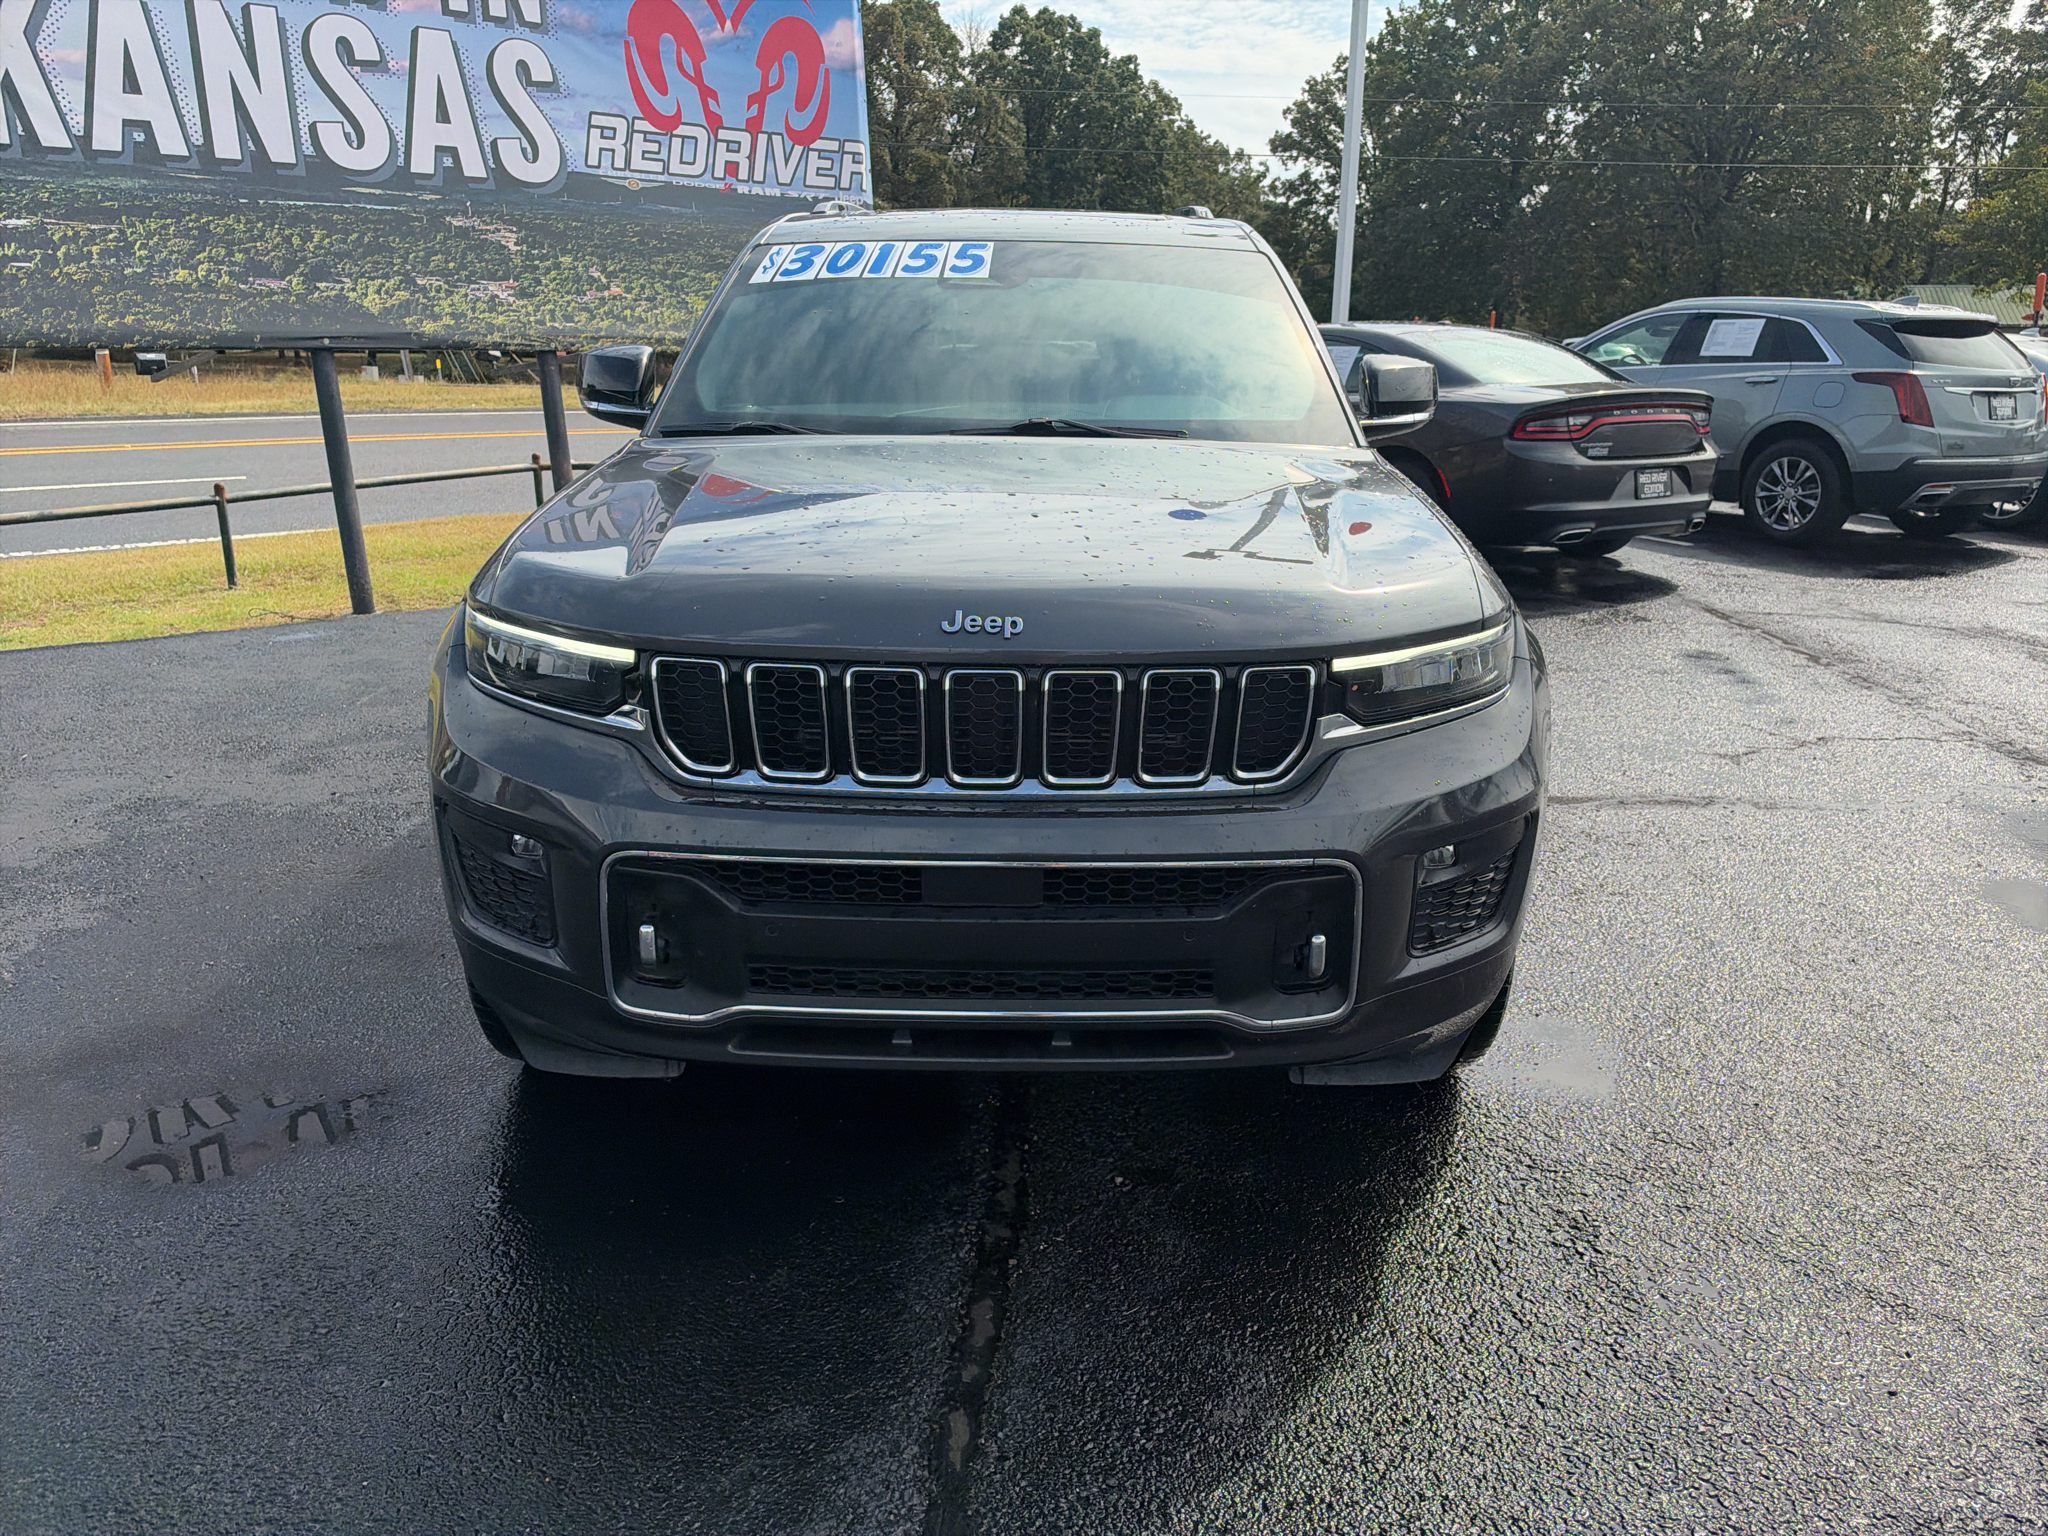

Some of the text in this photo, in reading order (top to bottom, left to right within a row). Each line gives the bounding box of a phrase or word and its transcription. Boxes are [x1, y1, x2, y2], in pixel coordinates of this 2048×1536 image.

[737, 185, 781, 198] RAM
[783, 190, 830, 202] SRT
[761, 242, 991, 277] $30155
[1640, 472, 1668, 483] RED RIVER
[941, 609, 1024, 639] Jeep
